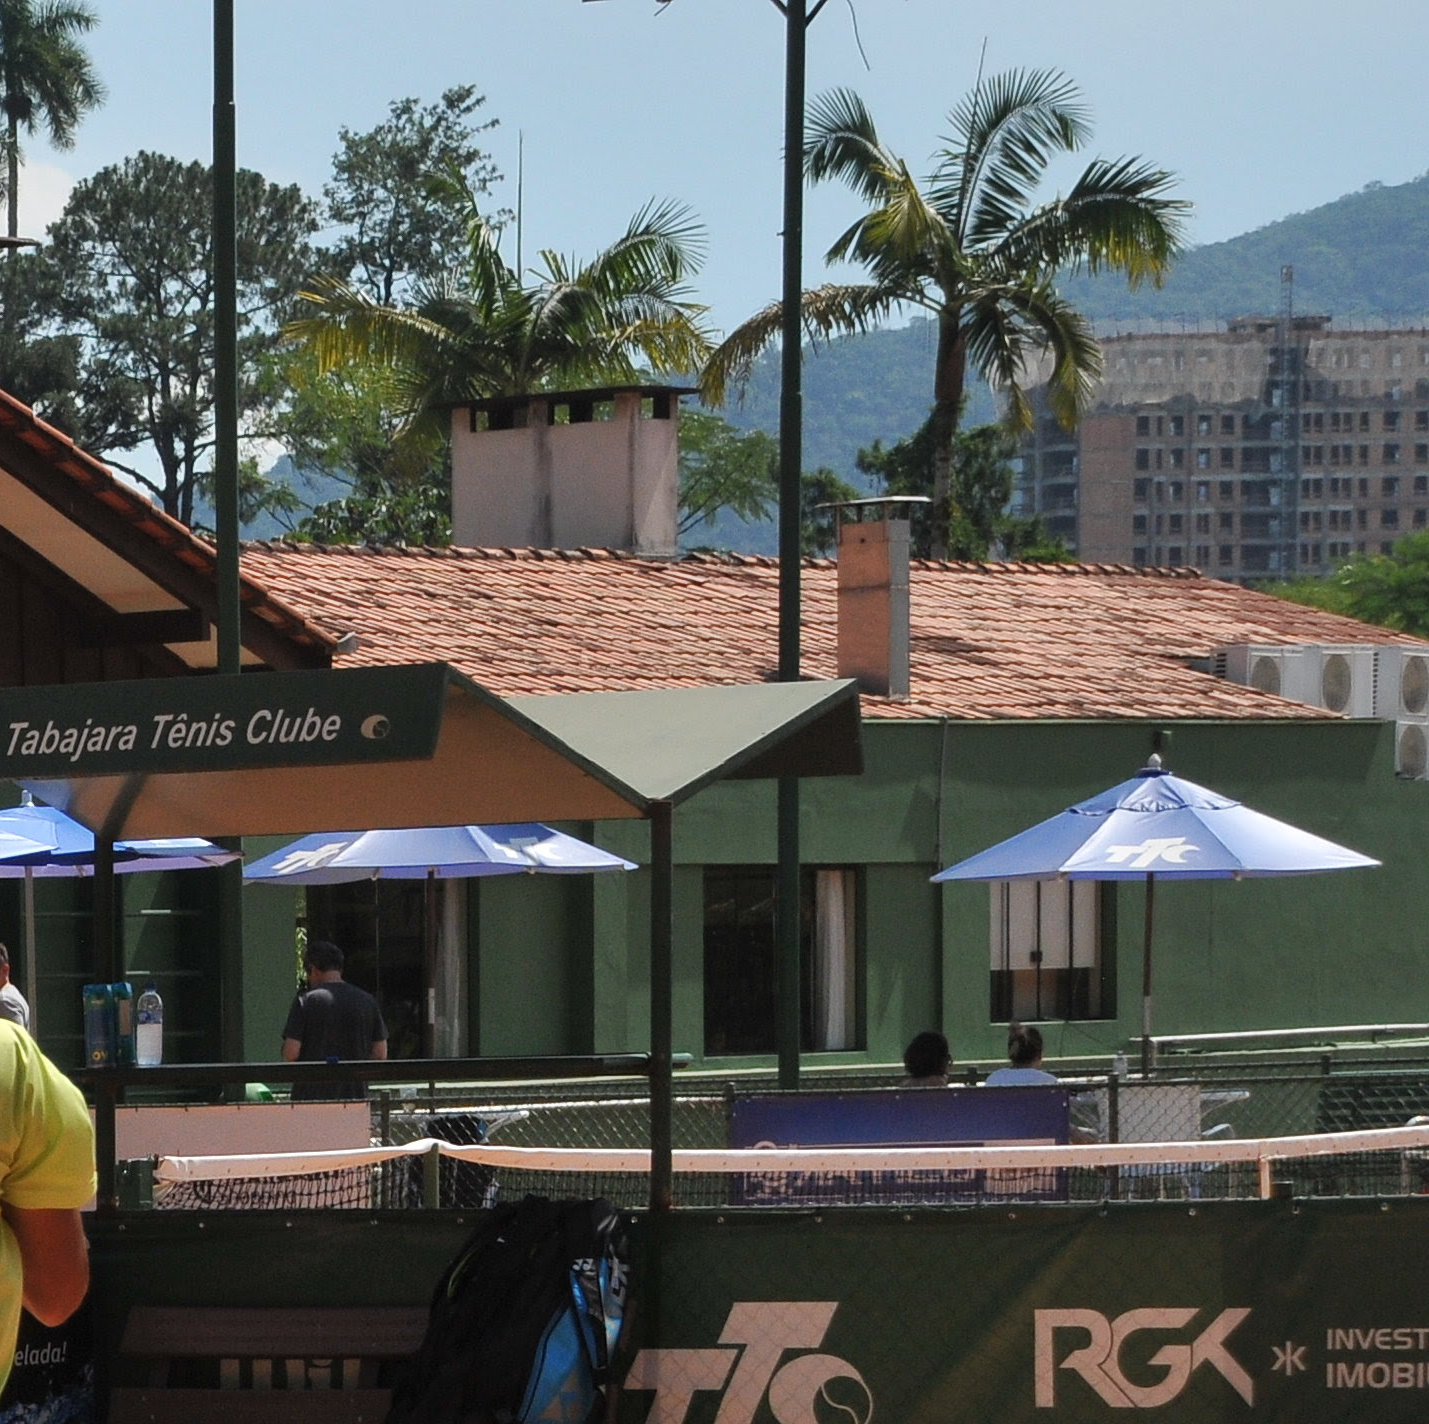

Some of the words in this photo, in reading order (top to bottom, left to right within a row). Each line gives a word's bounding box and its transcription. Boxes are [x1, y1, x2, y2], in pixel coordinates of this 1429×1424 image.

[6, 718, 138, 762] Tabajara
[150, 713, 236, 749] Tênis
[246, 707, 341, 744] Clube
[1326, 1328, 1429, 1350] INVEST
[14, 1341, 67, 1367] elada!
[1034, 1307, 1253, 1408] RGK
[1326, 1362, 1429, 1389] IMOBI
